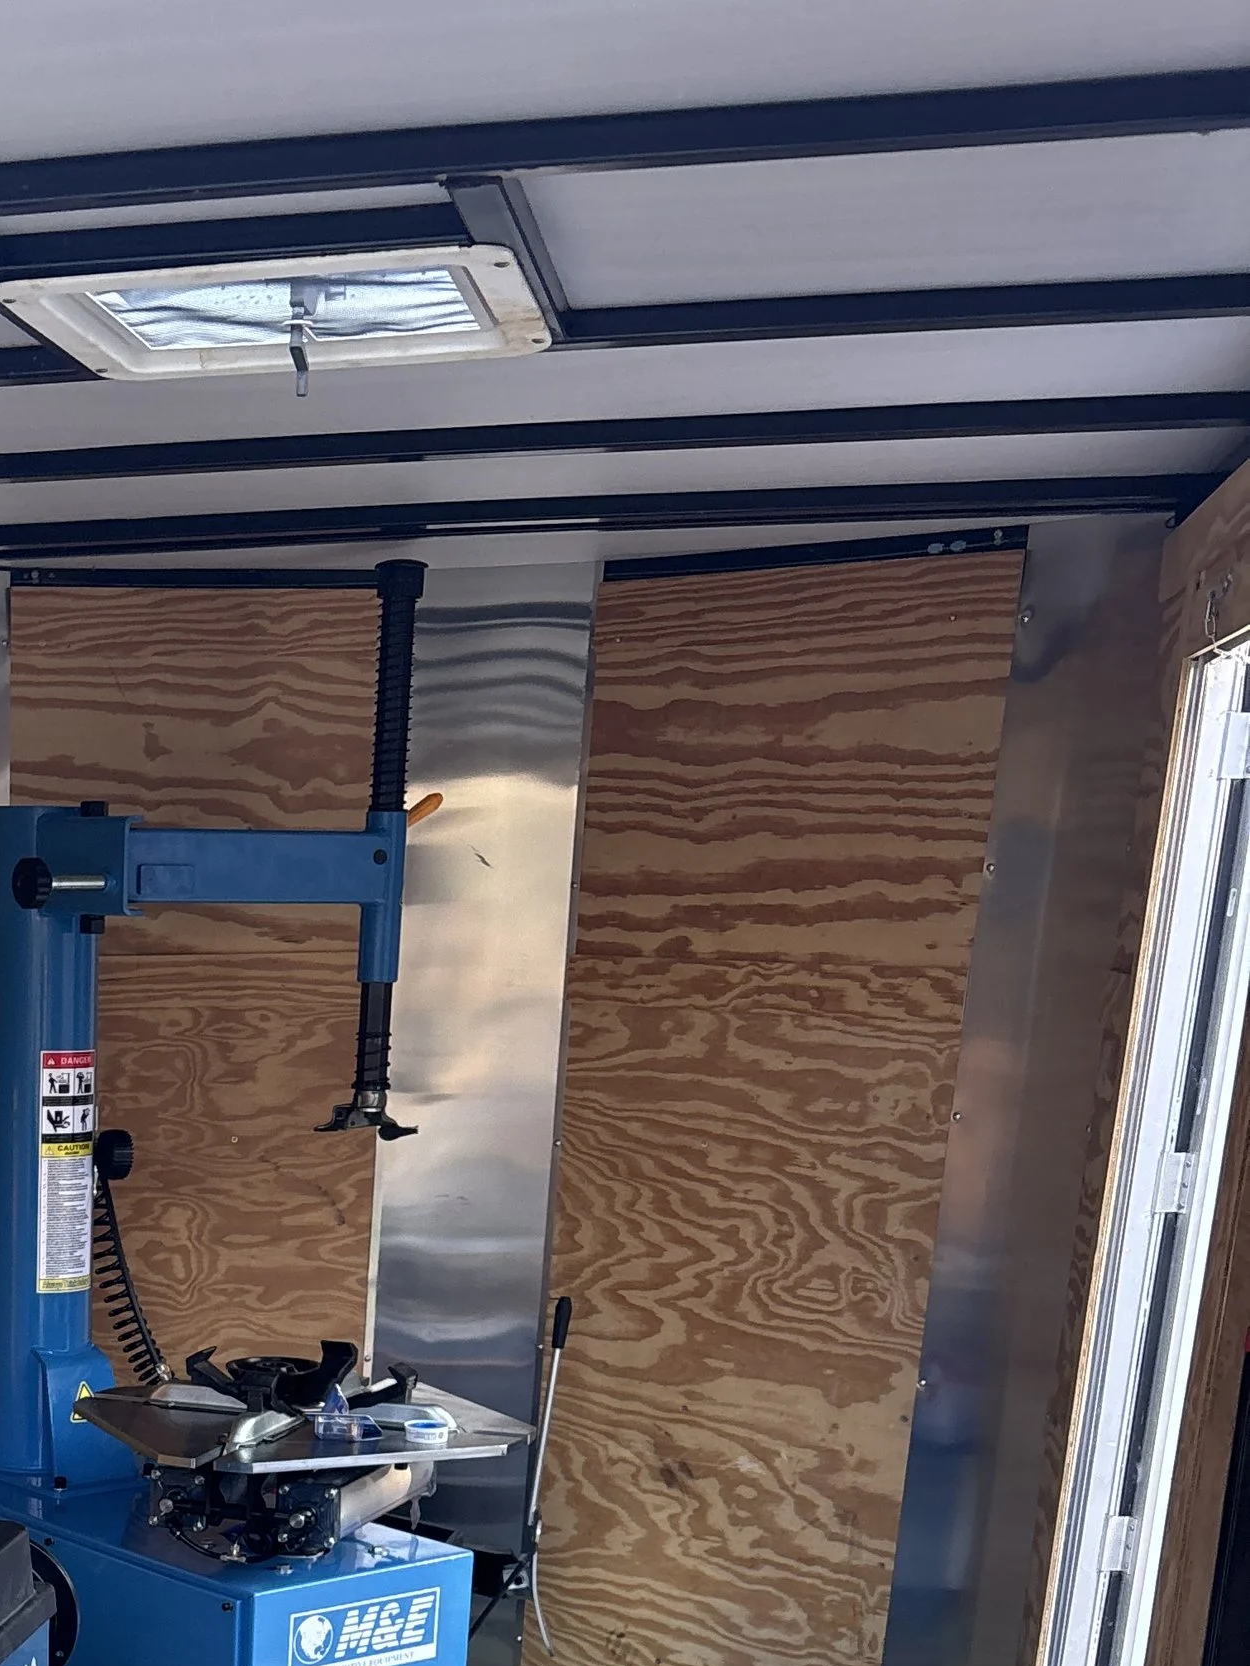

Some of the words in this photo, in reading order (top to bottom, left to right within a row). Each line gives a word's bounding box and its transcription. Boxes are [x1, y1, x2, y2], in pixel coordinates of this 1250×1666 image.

[60, 1055, 92, 1066] DANGER
[57, 1143, 90, 1152] CAUTION
[334, 1595, 435, 1659] M&E
